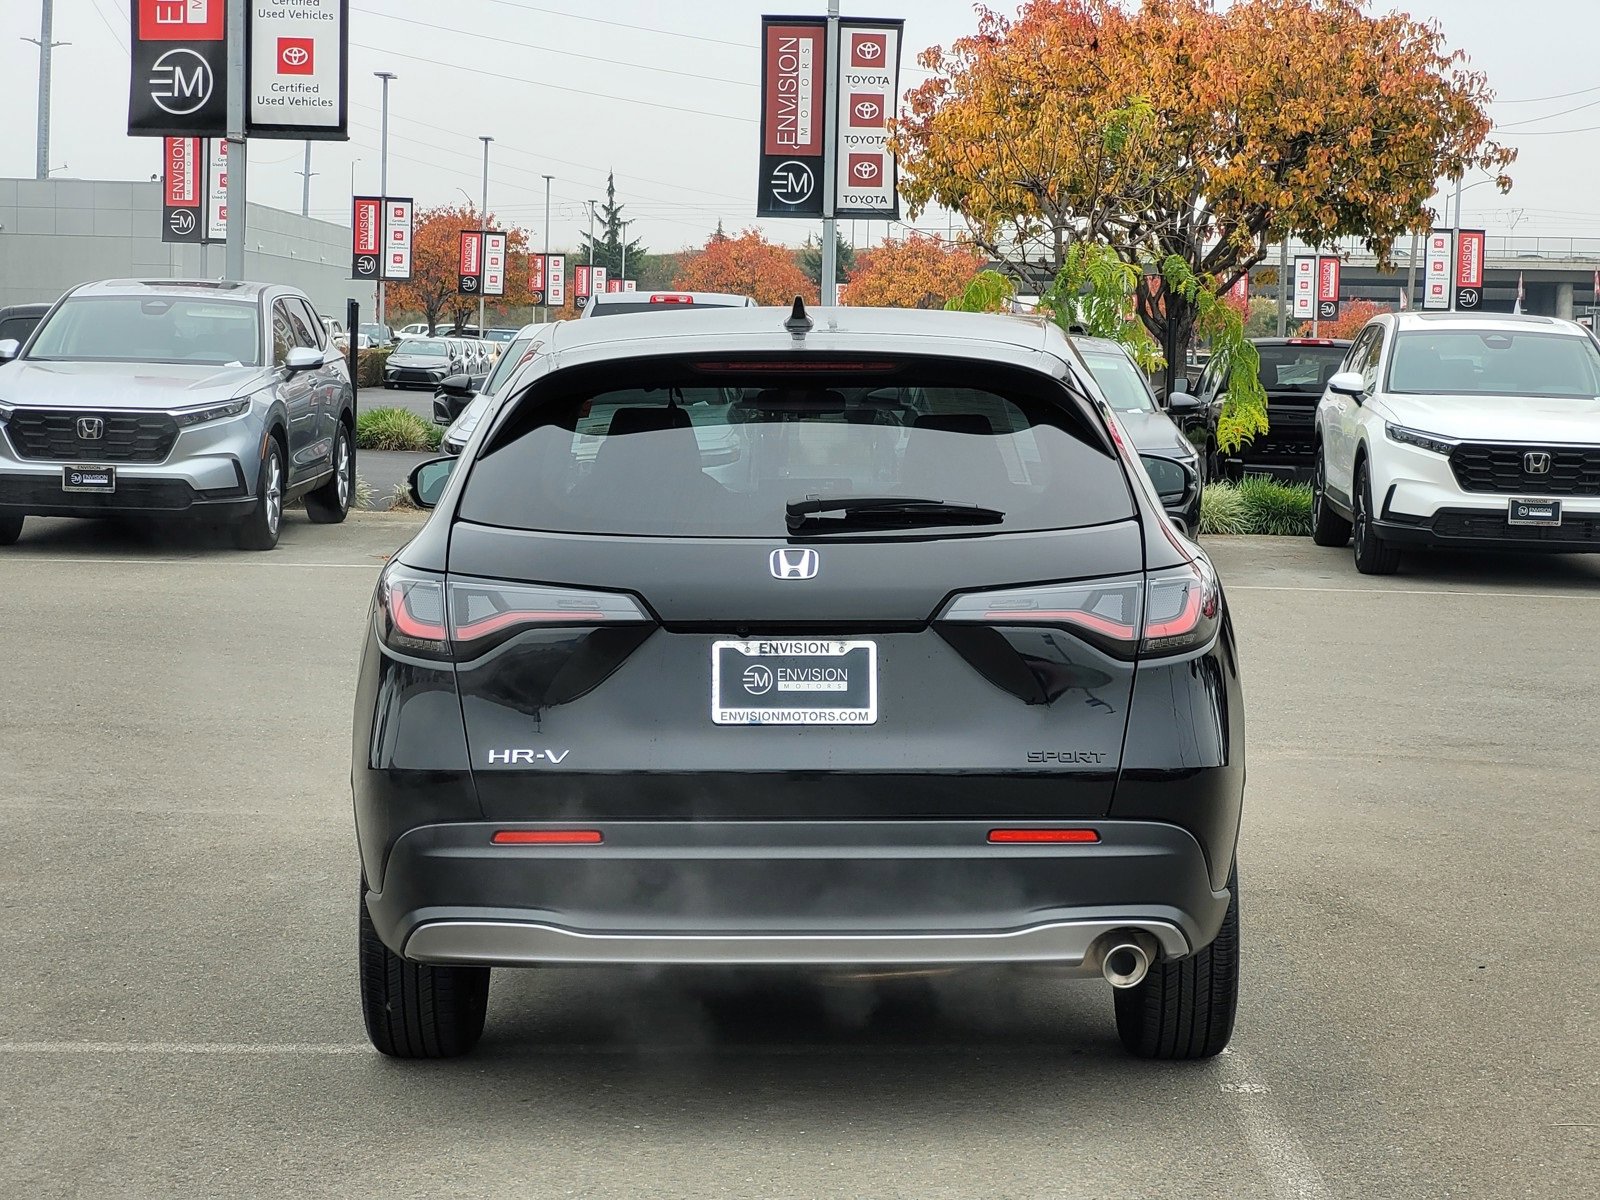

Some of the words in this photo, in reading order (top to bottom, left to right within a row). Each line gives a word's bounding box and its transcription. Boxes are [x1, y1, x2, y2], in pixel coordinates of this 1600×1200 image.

[258, 9, 285, 19] Used
[288, 10, 334, 21] Vehicles
[845, 75, 890, 85] TOYOTA
[271, 83, 320, 93] Certified
[776, 37, 798, 145] ENVISION
[800, 48, 810, 136] MOTORS
[257, 95, 285, 105] Used
[287, 97, 333, 107] Vehicles
[172, 137, 185, 201] ENVISION
[843, 195, 888, 205] TOYOTA
[359, 204, 369, 250] ENVISION
[464, 236, 472, 273] ENVISION
[1461, 237, 1472, 283] ENVISION
[1322, 262, 1331, 298] ENVISION
[759, 642, 830, 654] ENVISION
[777, 668, 848, 681] ENVISION
[720, 711, 869, 722] ENVISIONMOTORS.COM
[488, 749, 570, 765] HR-V
[1027, 750, 1107, 764] SPORT
